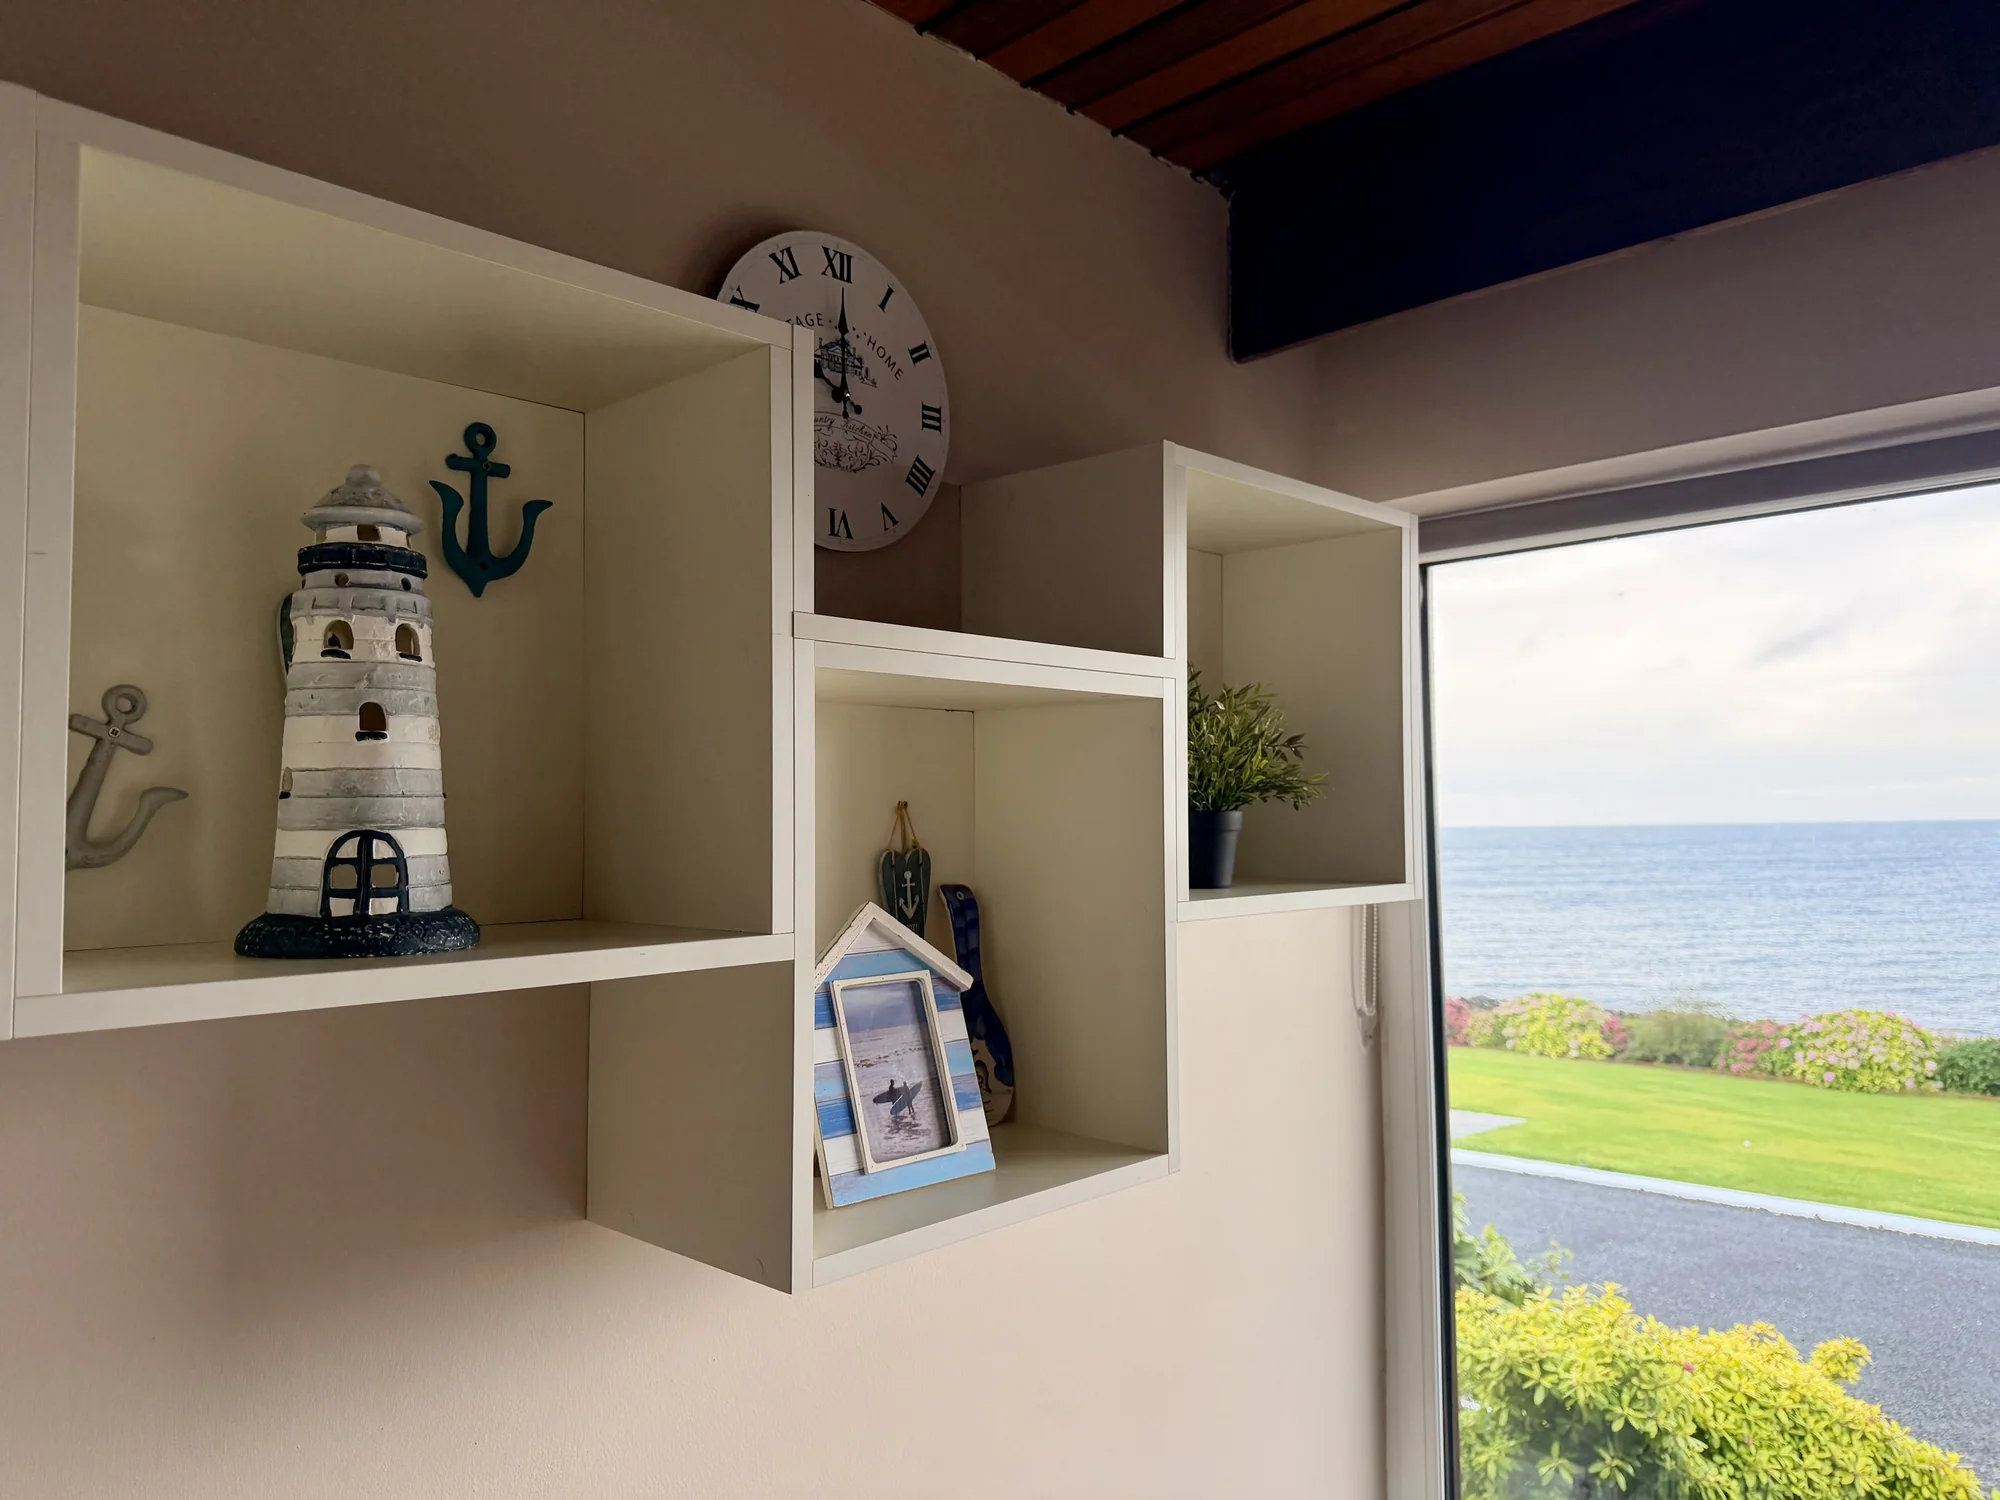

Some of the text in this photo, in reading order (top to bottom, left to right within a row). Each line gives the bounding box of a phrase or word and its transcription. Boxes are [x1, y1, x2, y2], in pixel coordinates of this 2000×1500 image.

[768, 246, 802, 284] XI
[820, 245, 854, 284] XII
[878, 285, 895, 313] I
[867, 335, 904, 380] HOME
[907, 340, 933, 365] II
[840, 419, 872, 438] Kitchen
[921, 401, 943, 434] III
[905, 455, 936, 497] IIII
[828, 507, 854, 540] VI
[880, 502, 899, 532] V
